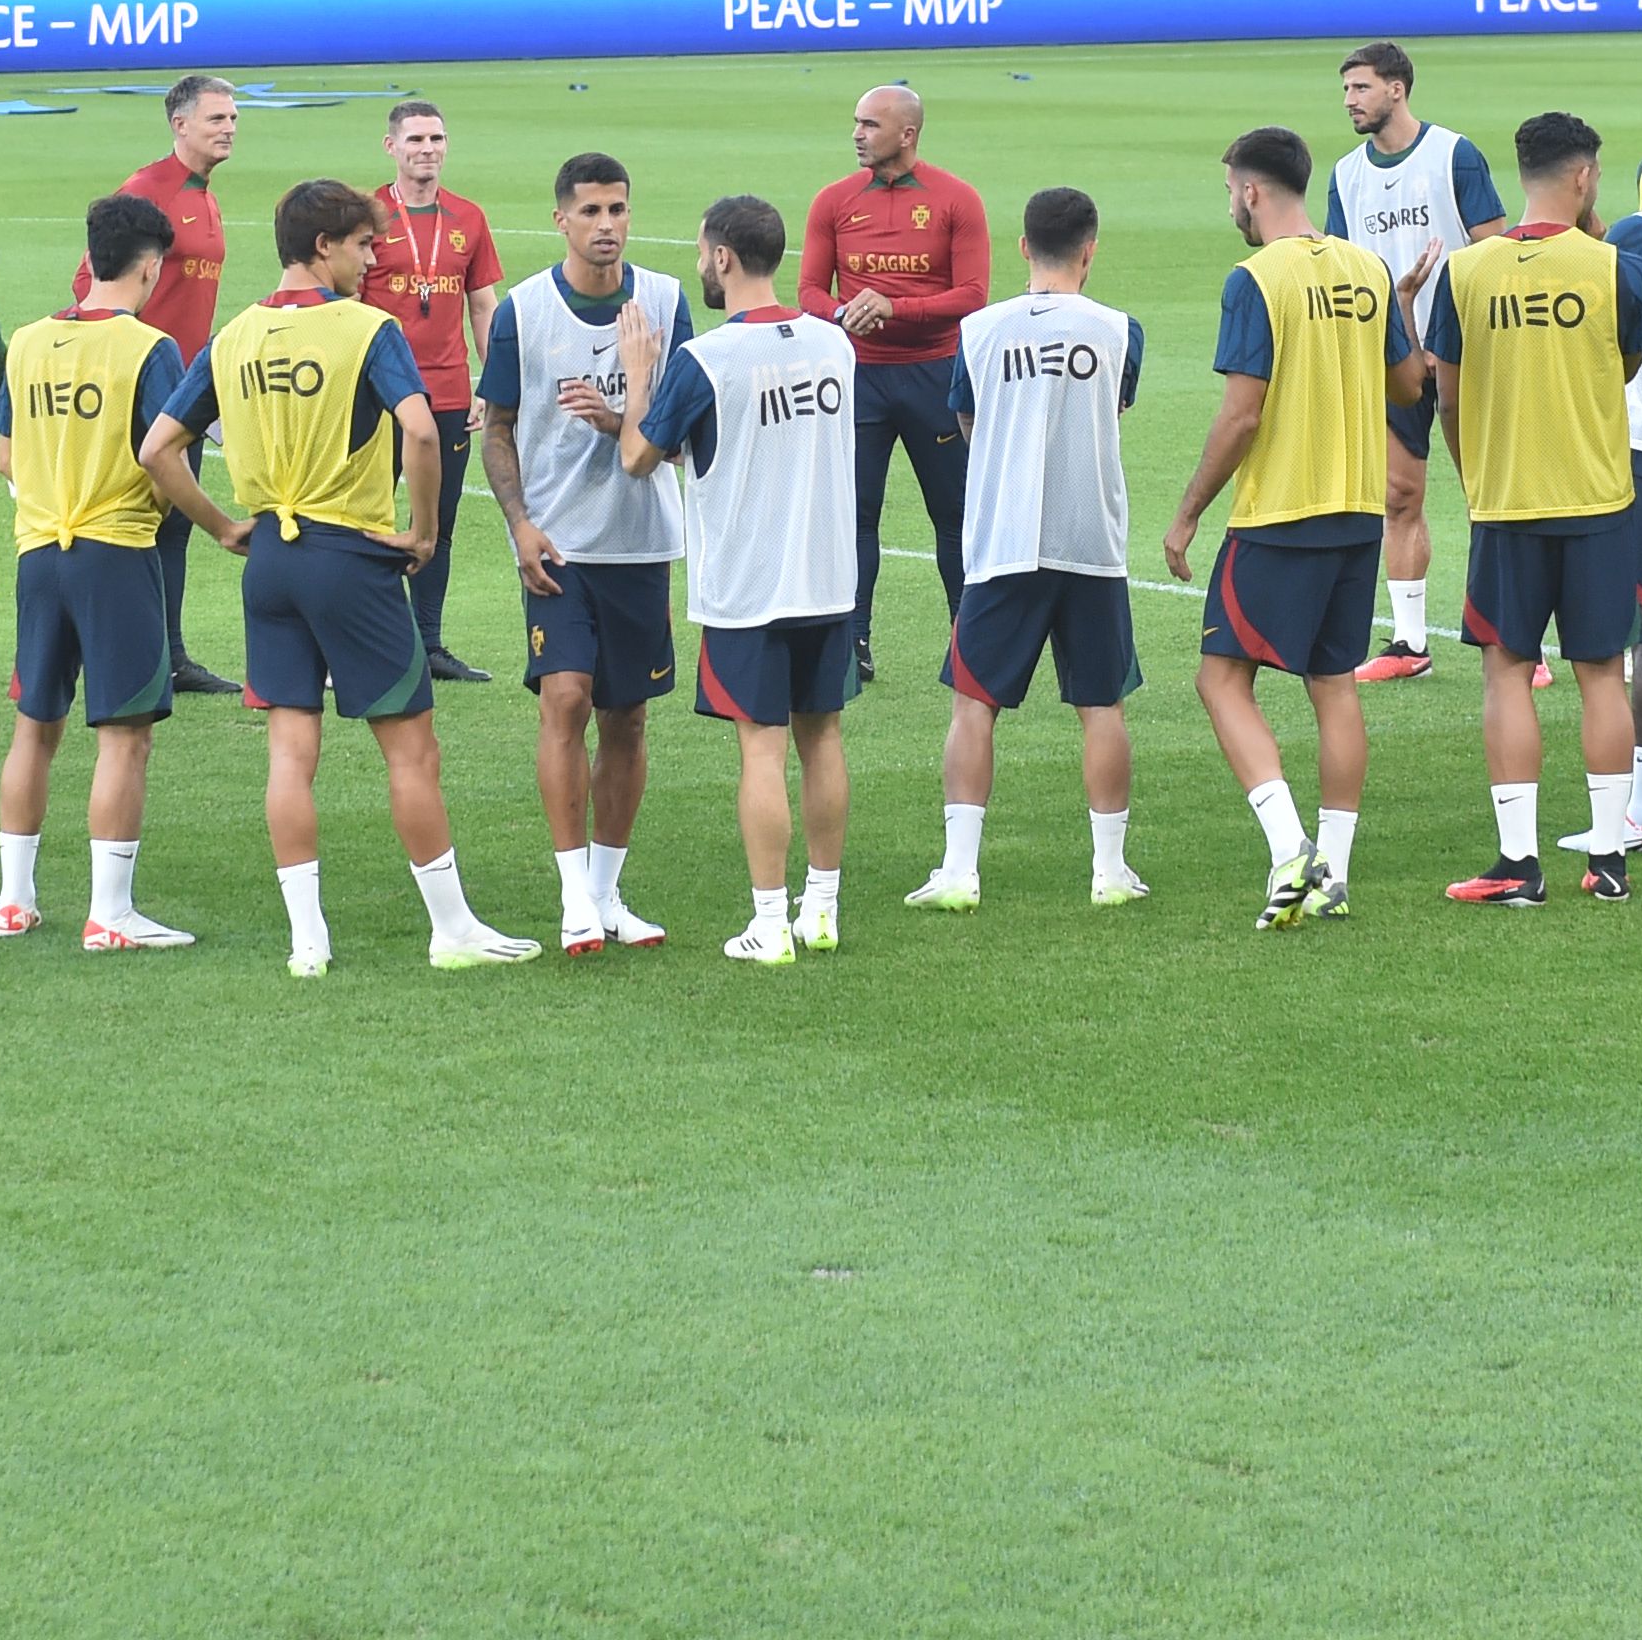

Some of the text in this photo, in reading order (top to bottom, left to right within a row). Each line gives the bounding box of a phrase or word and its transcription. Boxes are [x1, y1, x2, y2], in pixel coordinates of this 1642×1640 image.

[88, 1, 199, 46] МИР
[866, 253, 930, 273] SAGRES
[1307, 284, 1378, 323] MEO
[1489, 292, 1585, 330] MEO
[240, 358, 324, 399] MEO
[1003, 343, 1098, 382] MEO
[30, 382, 102, 420] MEO
[760, 378, 842, 427] MEO
